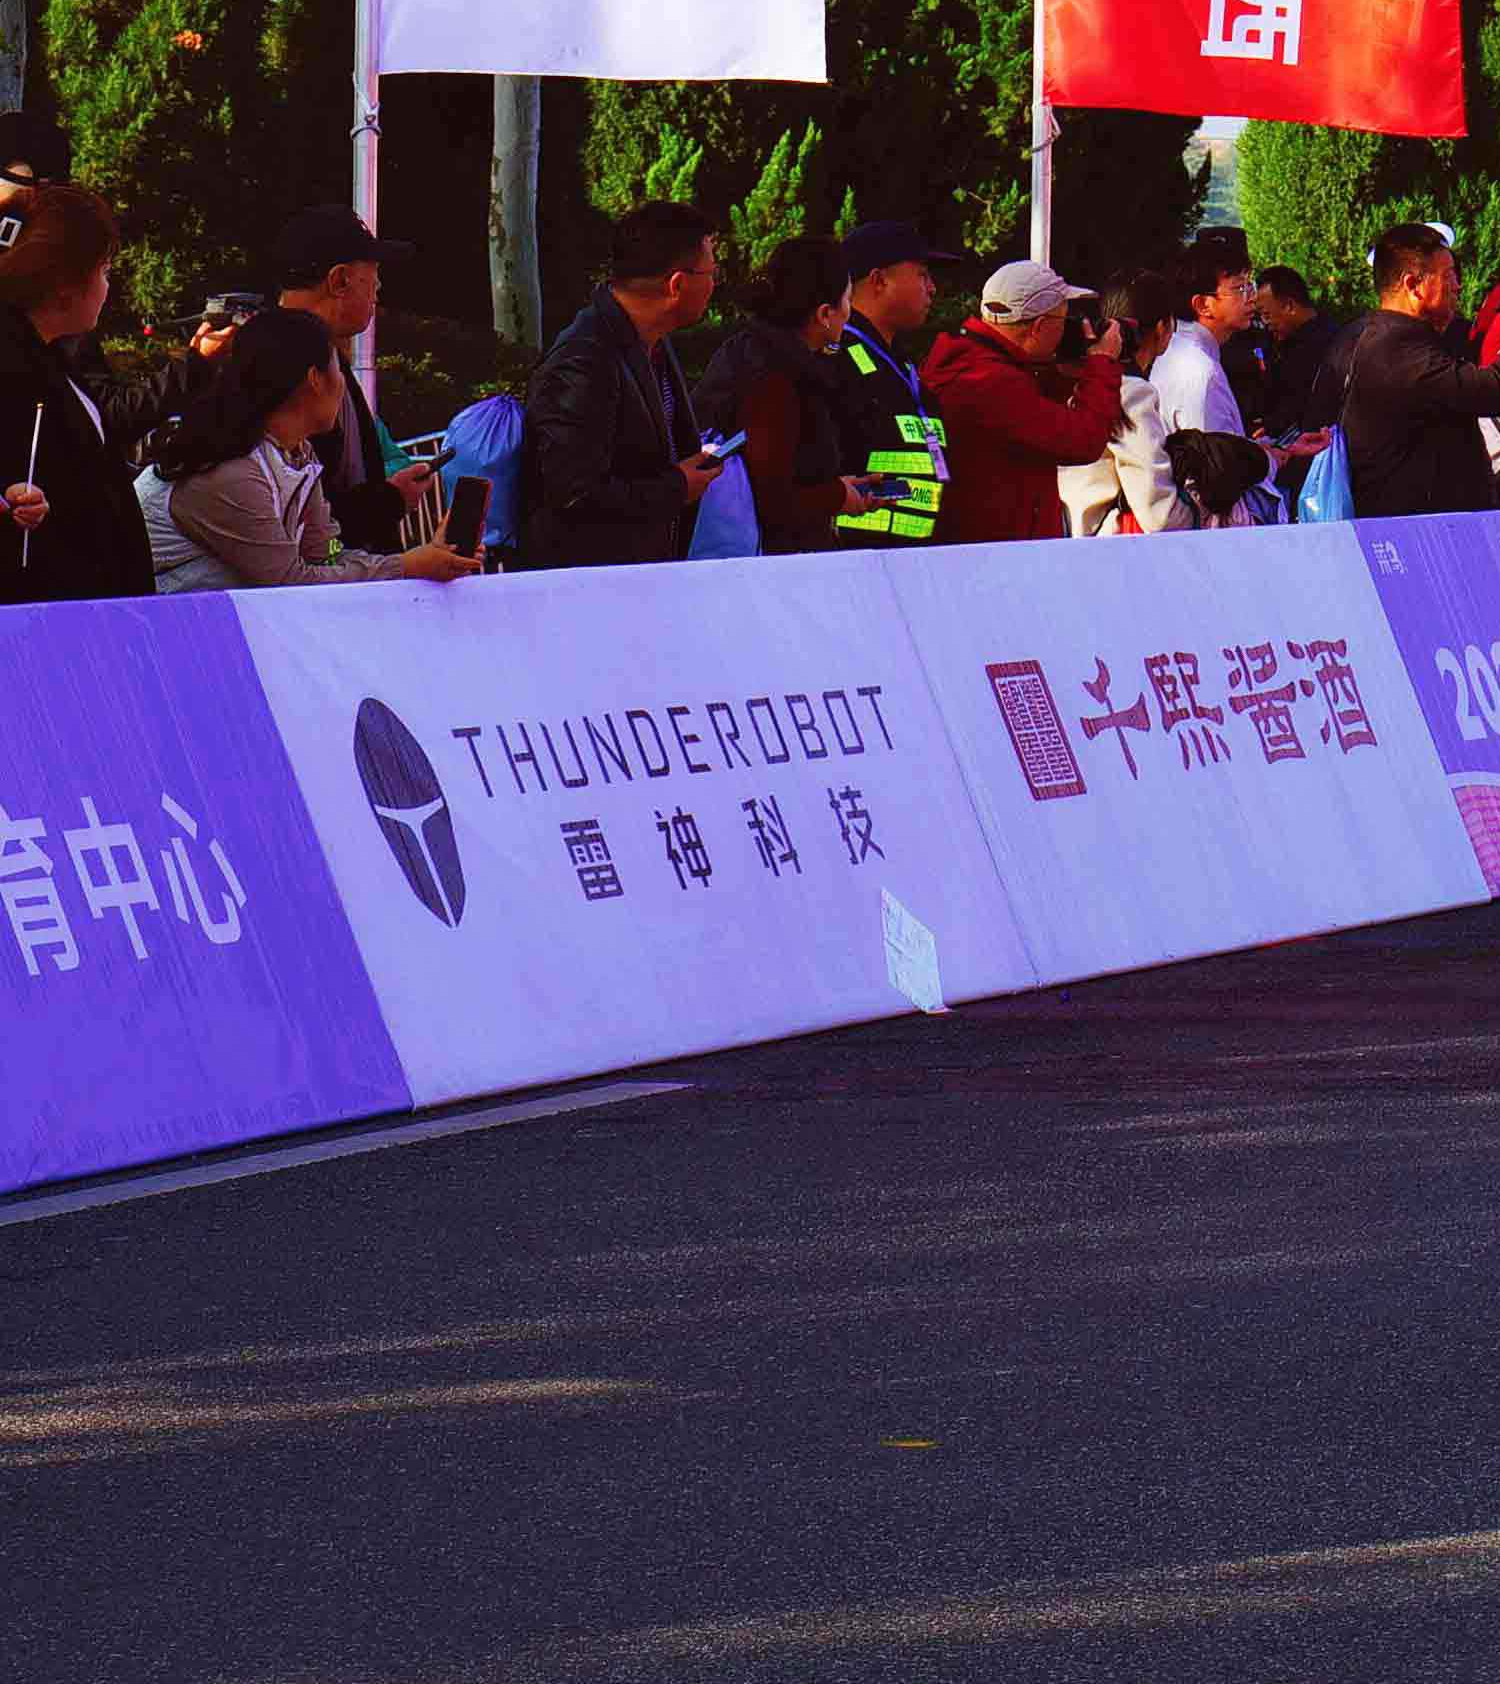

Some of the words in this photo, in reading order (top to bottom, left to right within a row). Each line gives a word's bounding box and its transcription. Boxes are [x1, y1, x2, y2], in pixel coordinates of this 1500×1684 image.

[452, 685, 894, 797] THUNDEROBOT
[560, 785, 886, 901] 雷神科技
